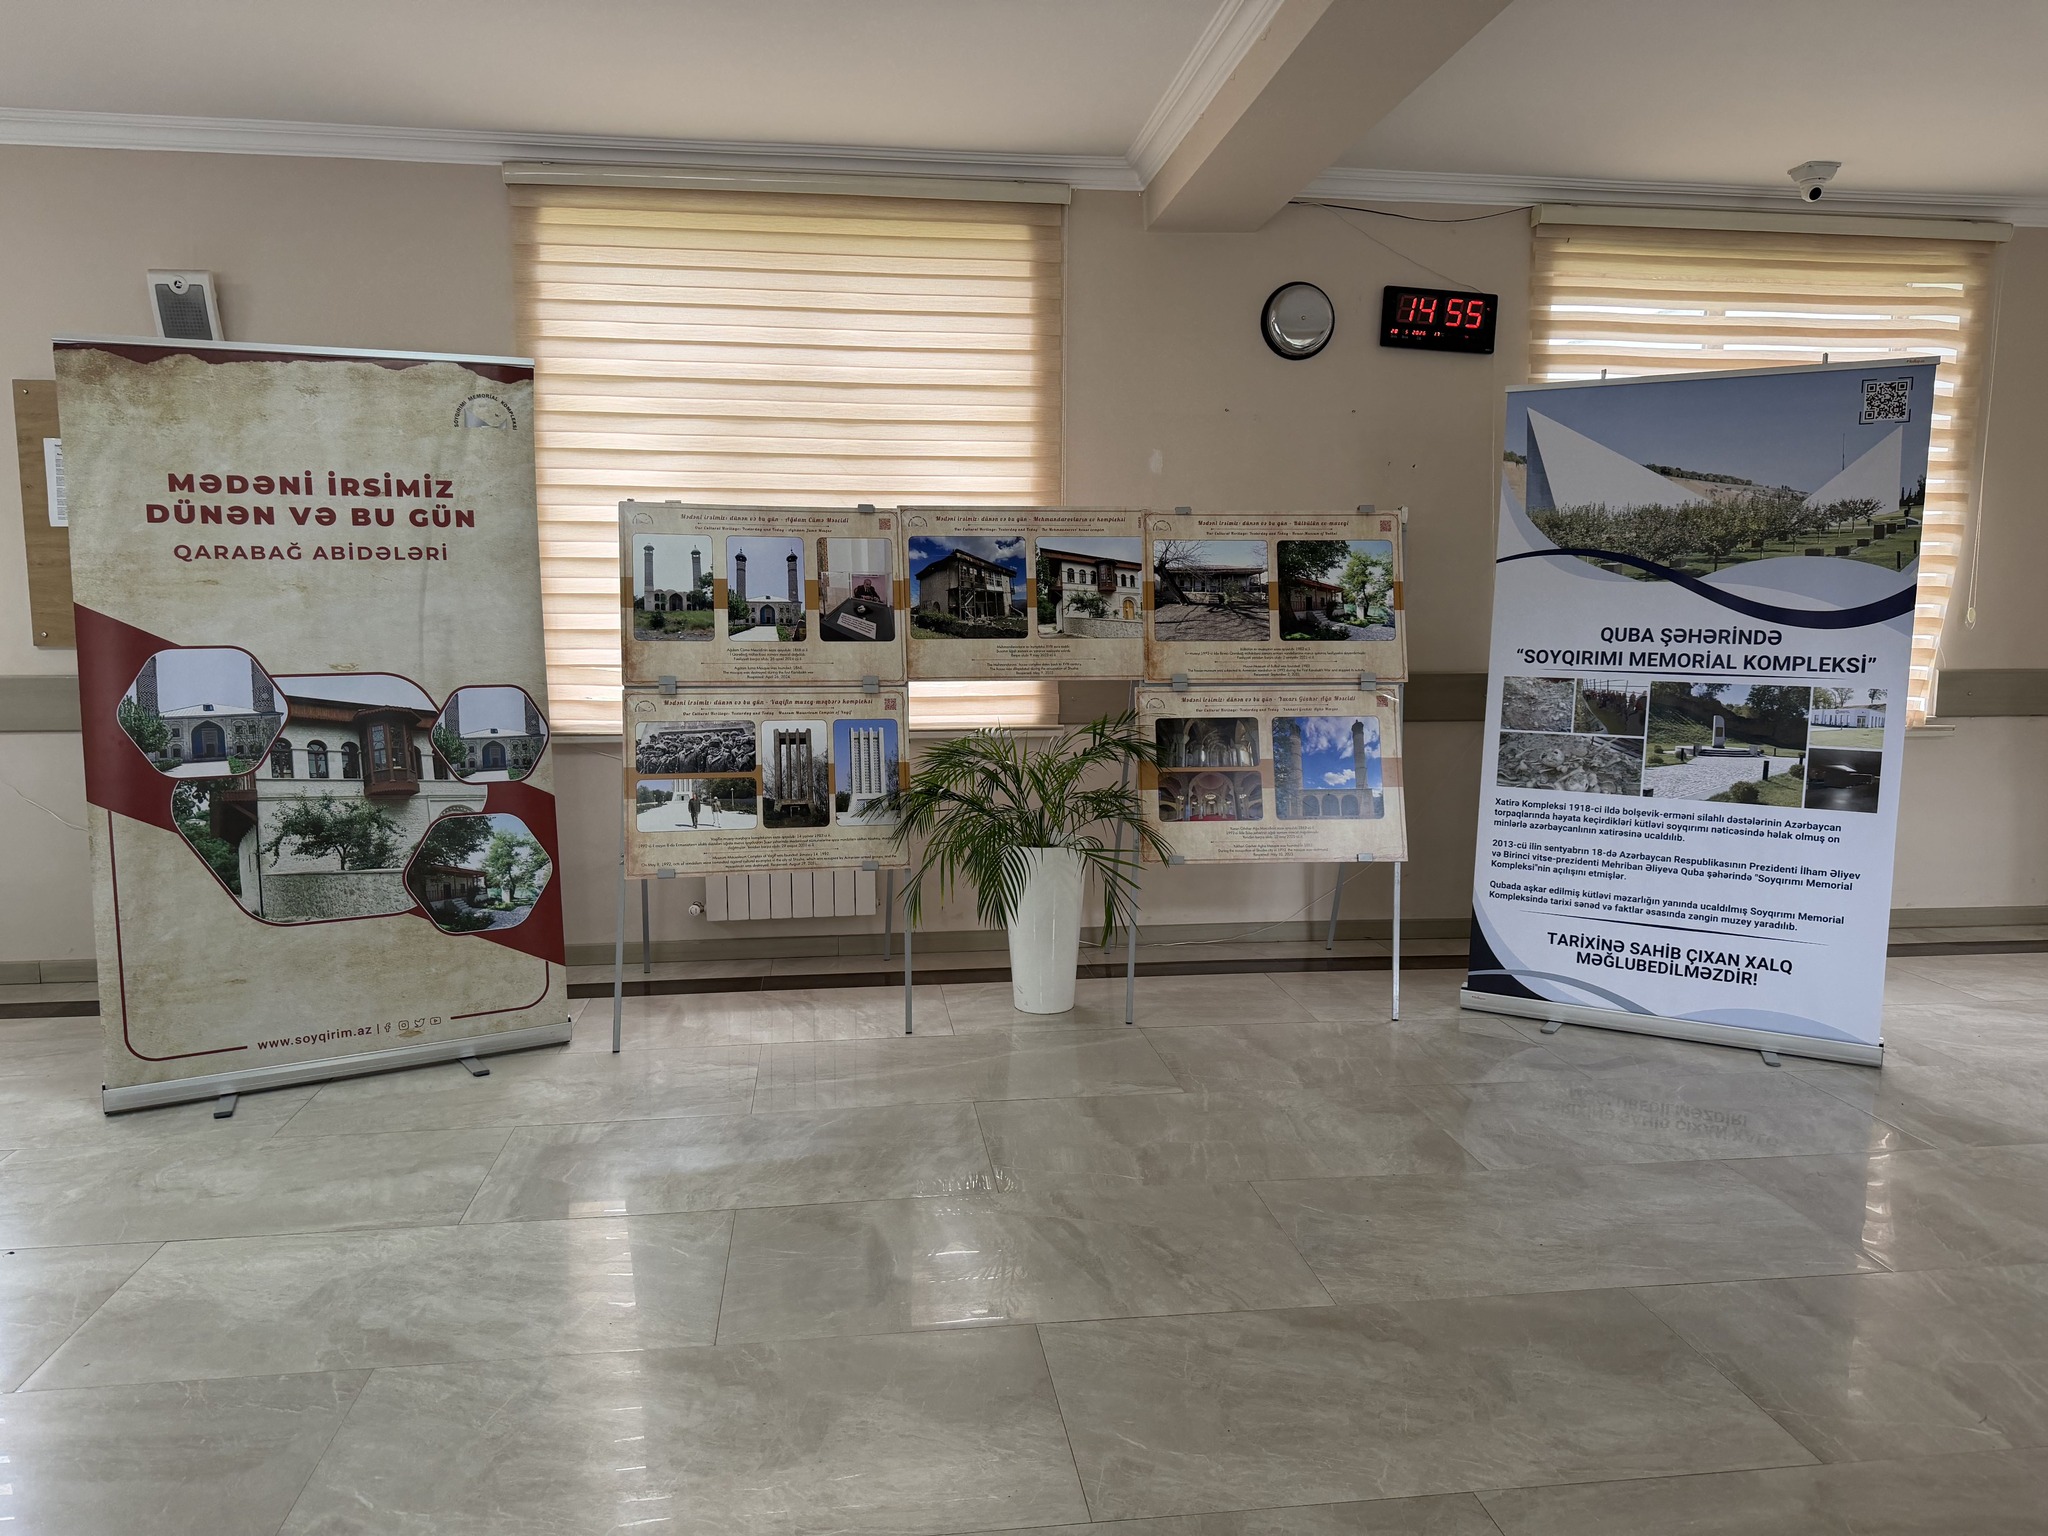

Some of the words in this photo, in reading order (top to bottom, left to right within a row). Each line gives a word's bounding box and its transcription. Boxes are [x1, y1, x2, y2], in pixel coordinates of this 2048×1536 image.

[1408, 297, 1437, 323] 14
[1445, 298, 1484, 329] 55
[167, 471, 313, 495] MƏDƏNİ
[327, 472, 454, 498] İRSİMİZ
[145, 498, 275, 525] DÜNƏN
[287, 506, 337, 526] VƏ
[350, 507, 395, 527] BU
[408, 503, 475, 528] GÜN
[172, 542, 302, 562] QARABAĞ
[312, 542, 447, 561] ABİDƏLƏRİ
[1600, 626, 1654, 643] QUBA
[1660, 626, 1782, 646] ŞƏHƏRİNDƏ
[1516, 648, 1623, 666] “SOYQIRIMI
[1628, 650, 1737, 669] MEMORİAL
[1743, 654, 1876, 673] KOMPLEKSİ”
[1493, 819, 1527, 828] minlərlə
[1529, 822, 1596, 833] azərbaycanlının
[1598, 828, 1642, 838] xatirəsinə
[1644, 832, 1685, 841] ucaldılıb.
[1494, 809, 1550, 819] torpaqlarında
[1552, 812, 1580, 822] həyata
[1582, 815, 1632, 826] keçirdikləri
[1634, 818, 1664, 828] kütləvi
[1666, 823, 1708, 832] soyqırımı
[1710, 826, 1764, 837] nəticəsində
[1766, 829, 1793, 839] həlak
[1794, 832, 1825, 844] olmuş
[1495, 797, 1520, 806] Xatirə
[1521, 799, 1566, 810] Kompleksi
[1569, 803, 1602, 813] 1918-ci
[1604, 805, 1620, 814] ildə
[1622, 807, 1695, 820] bolşevik-erməni
[1696, 813, 1724, 822] silahlı
[1726, 815, 1782, 827] dəstələrinin
[1783, 820, 1841, 832] Azərbaycan
[1490, 859, 1550, 872] Kompleksi"nin
[1552, 866, 1586, 876] açılışını
[1587, 870, 1626, 880] etmişlər.
[1492, 839, 1527, 849] 2013-cü
[1528, 842, 1542, 850] ilin
[1544, 845, 1589, 854] sentyabrın
[1592, 848, 1617, 857] 18-də
[1618, 851, 1671, 862] Azərbaycan
[1673, 855, 1746, 869] Respublikasının
[1748, 862, 1797, 874] Prezidenti
[1800, 865, 1827, 876] İlham
[1829, 869, 1860, 880] Əliyev
[1503, 850, 1530, 860] Birinci
[1531, 854, 1599, 866] vitse-prezidenti
[1601, 859, 1643, 870] Mehriban
[1645, 863, 1678, 874] Əliyeva
[1680, 867, 1704, 876] Quba
[1706, 870, 1752, 881] şəhərində
[1754, 873, 1803, 886] "Soyqırımı
[1805, 878, 1852, 890] Memorial
[1488, 890, 1548, 903] Kompleksində
[1549, 897, 1572, 906] tarixi
[1573, 901, 1600, 909] sənəd
[1614, 903, 1644, 914] faktlar
[1645, 908, 1686, 919] əsasında
[1687, 913, 1718, 923] zəngin
[1720, 916, 1752, 927] muzey
[1753, 920, 1797, 930] yaradılıb.
[1489, 880, 1521, 890] Qubada
[1523, 884, 1547, 893] aşkar
[1548, 886, 1580, 898] edilmiş
[1582, 889, 1611, 899] kütləvi
[1613, 894, 1660, 906] məzarlığın
[1662, 900, 1698, 909] yanında
[1700, 903, 1748, 915] ucaldılmış
[1749, 907, 1795, 919] Soyqırımı
[1797, 912, 1844, 924] Memorial
[1546, 932, 1625, 953] TARİXİNƏ
[1629, 942, 1682, 960] SAHİB
[1685, 948, 1740, 968] ÇIXAN
[1744, 955, 1793, 975] XALQ
[1576, 951, 1758, 986] MƏĞLUBEDİLMƏZDİR!
[257, 1025, 373, 1050] www.soyqirim.az
